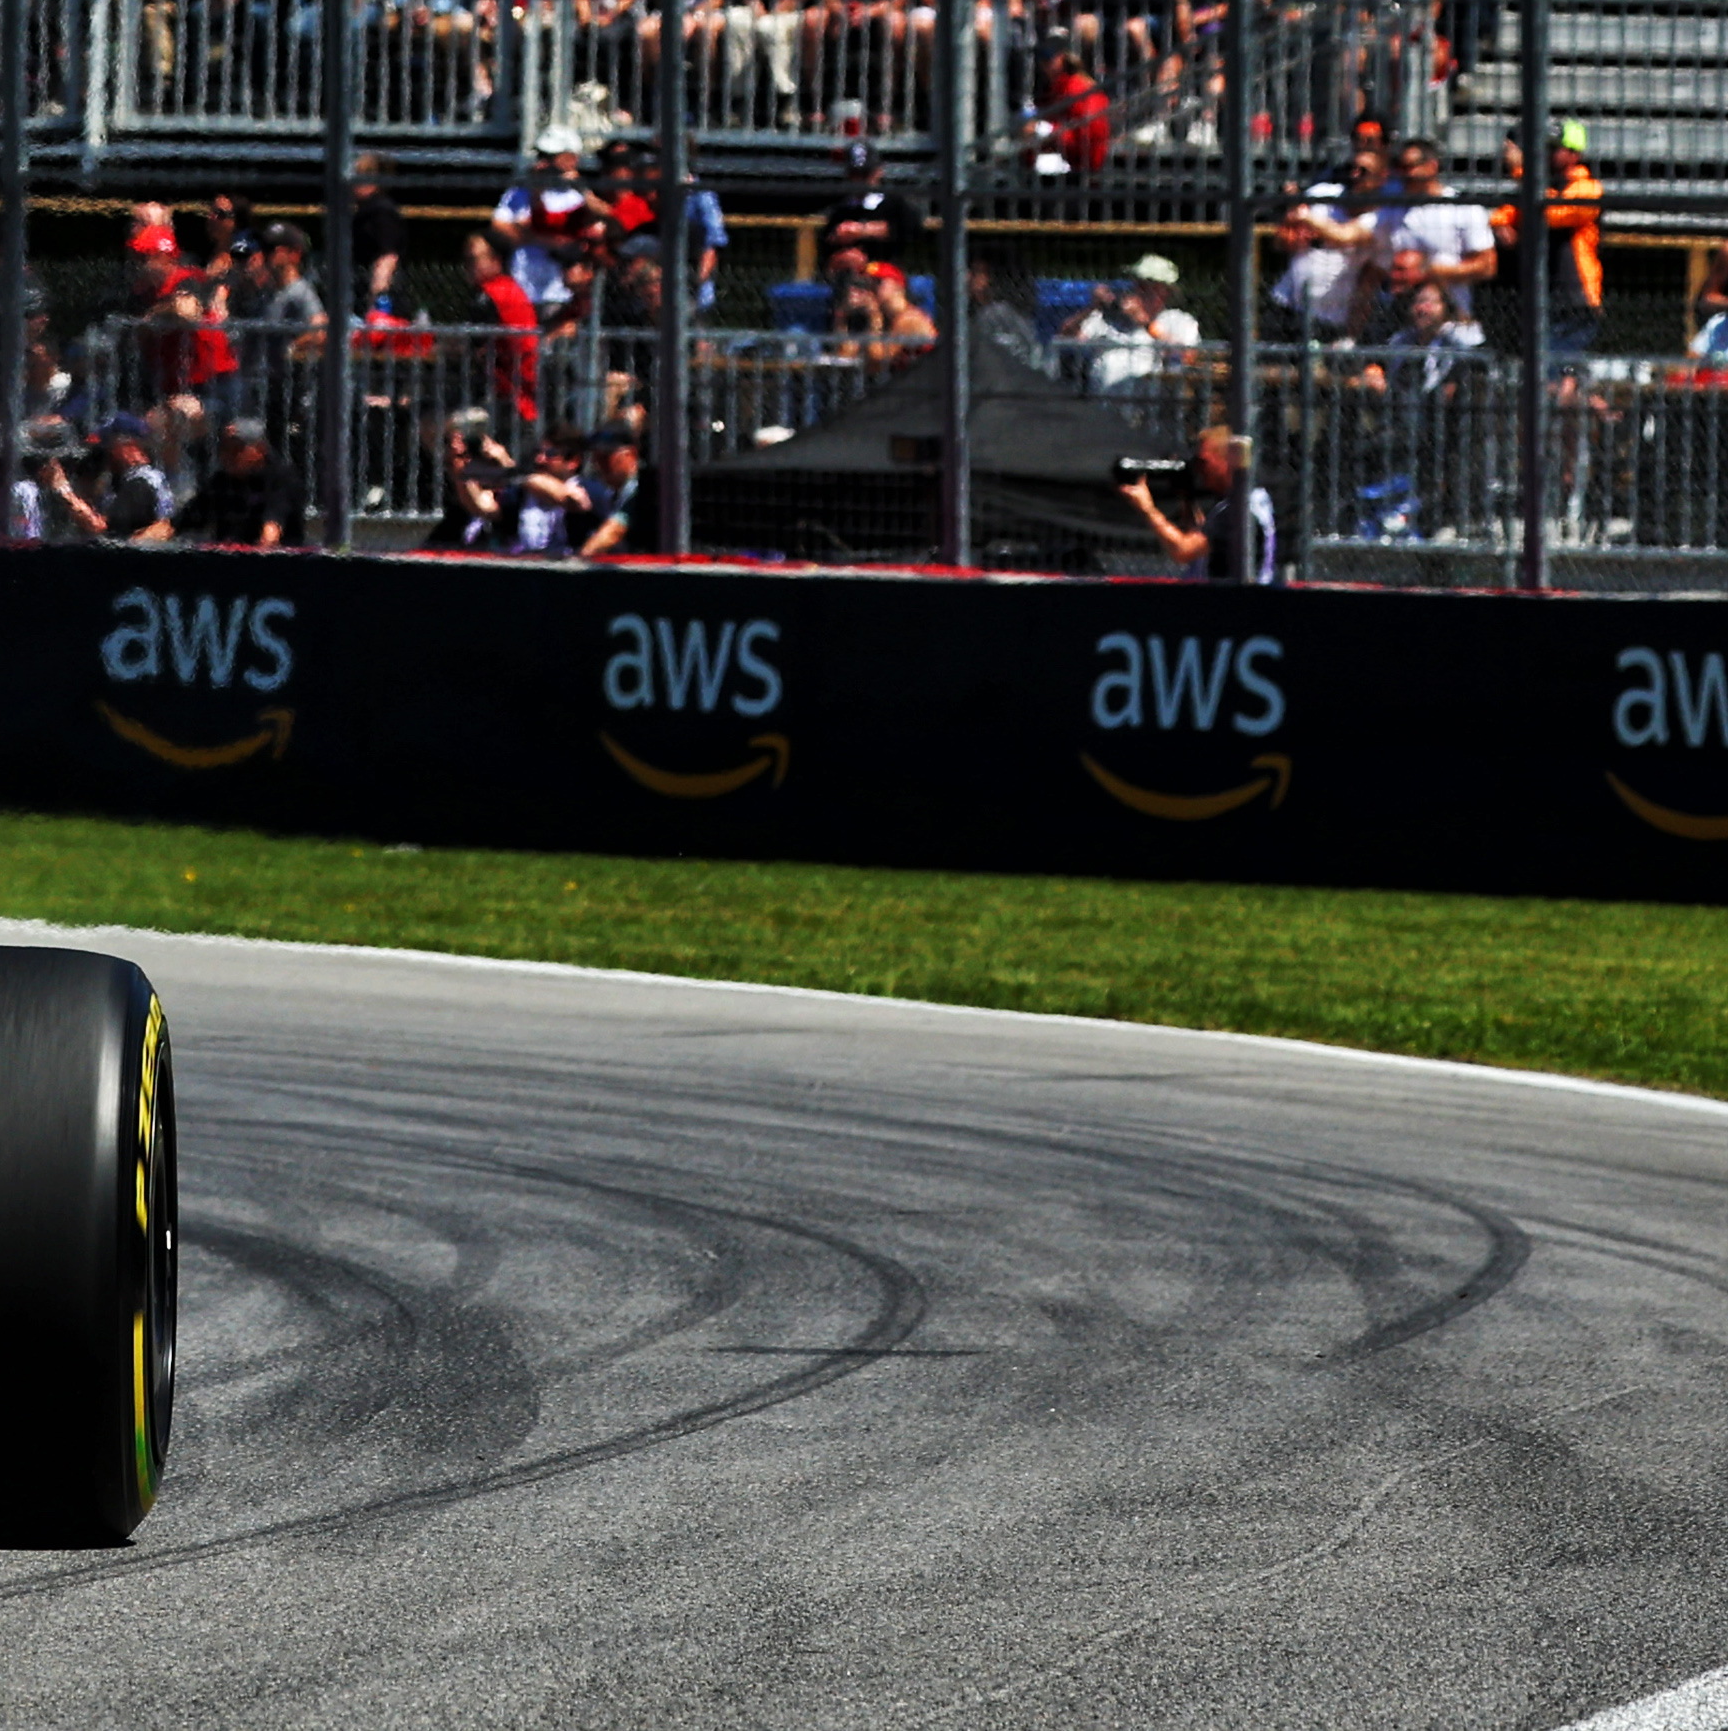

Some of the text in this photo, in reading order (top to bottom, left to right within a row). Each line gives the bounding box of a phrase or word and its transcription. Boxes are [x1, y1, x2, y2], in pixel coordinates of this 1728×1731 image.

[101, 586, 296, 692] aws
[604, 615, 782, 717] aws
[1091, 632, 1286, 737] aws
[1613, 646, 1728, 747] aw
